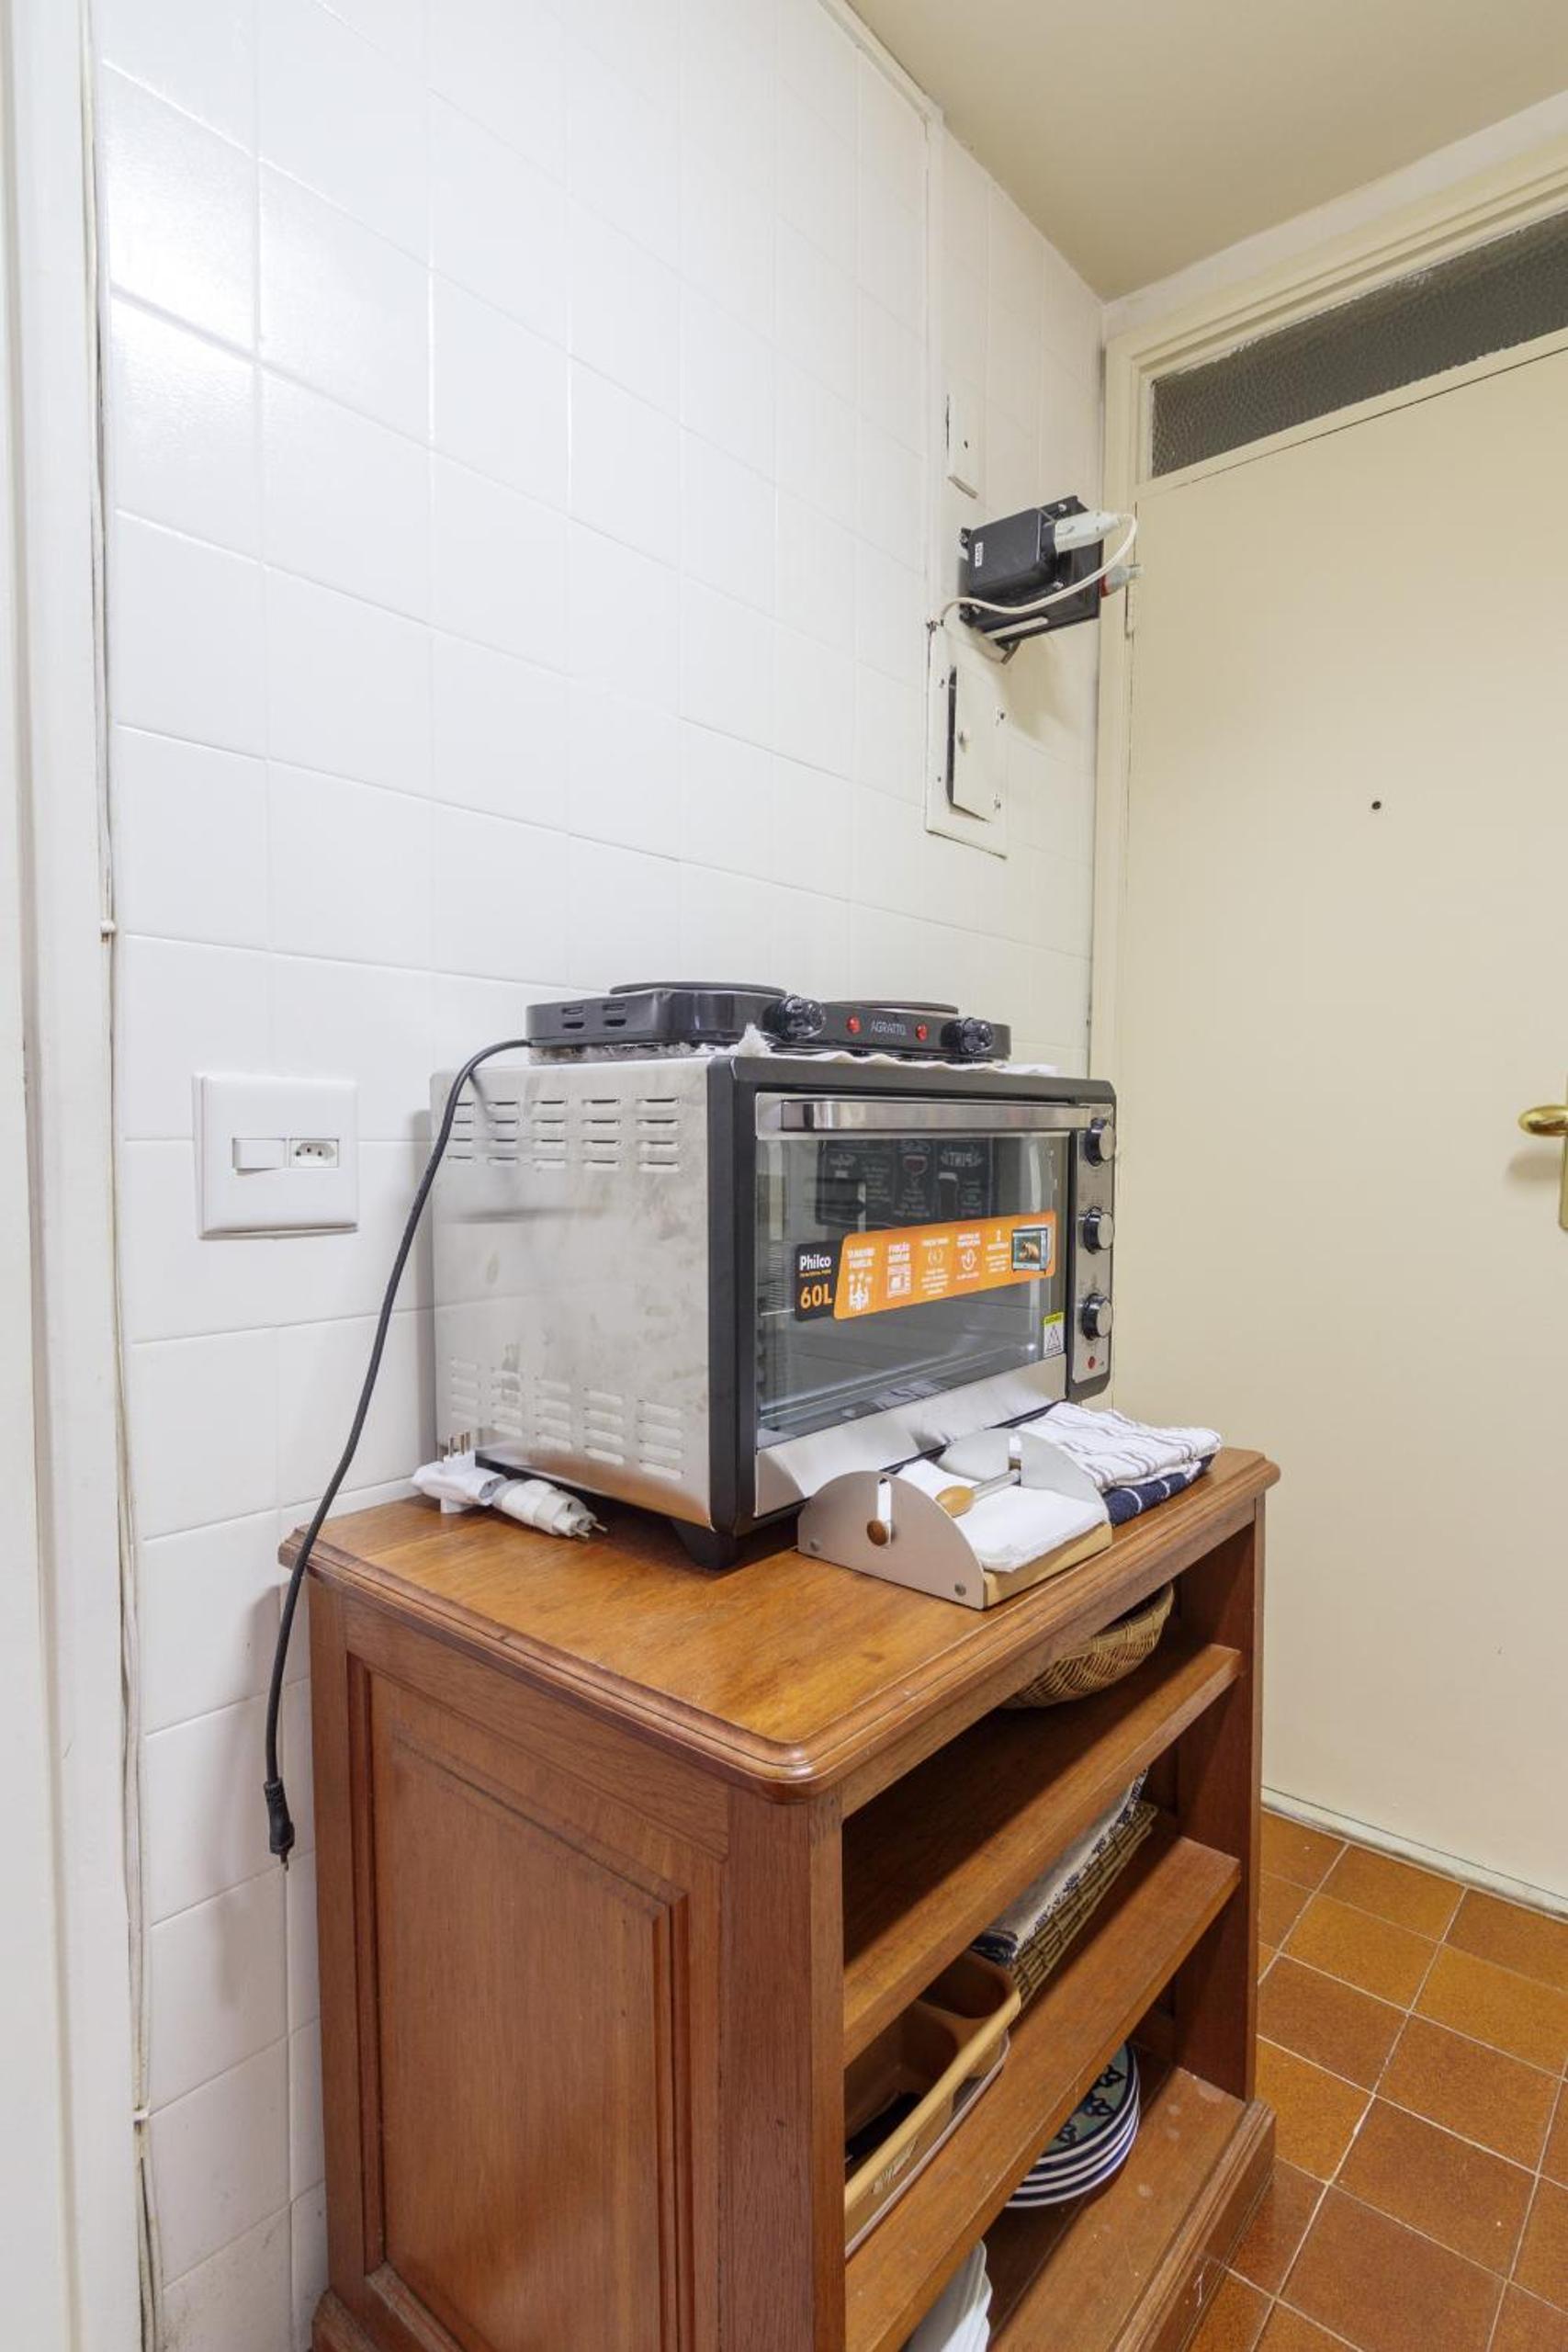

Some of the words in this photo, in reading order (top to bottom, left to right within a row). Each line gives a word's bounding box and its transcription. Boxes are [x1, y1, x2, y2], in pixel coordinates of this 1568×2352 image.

[871, 1020, 907, 1035] AGRATTO
[799, 1254, 832, 1271] Philco
[800, 1283, 833, 1309] 60L
